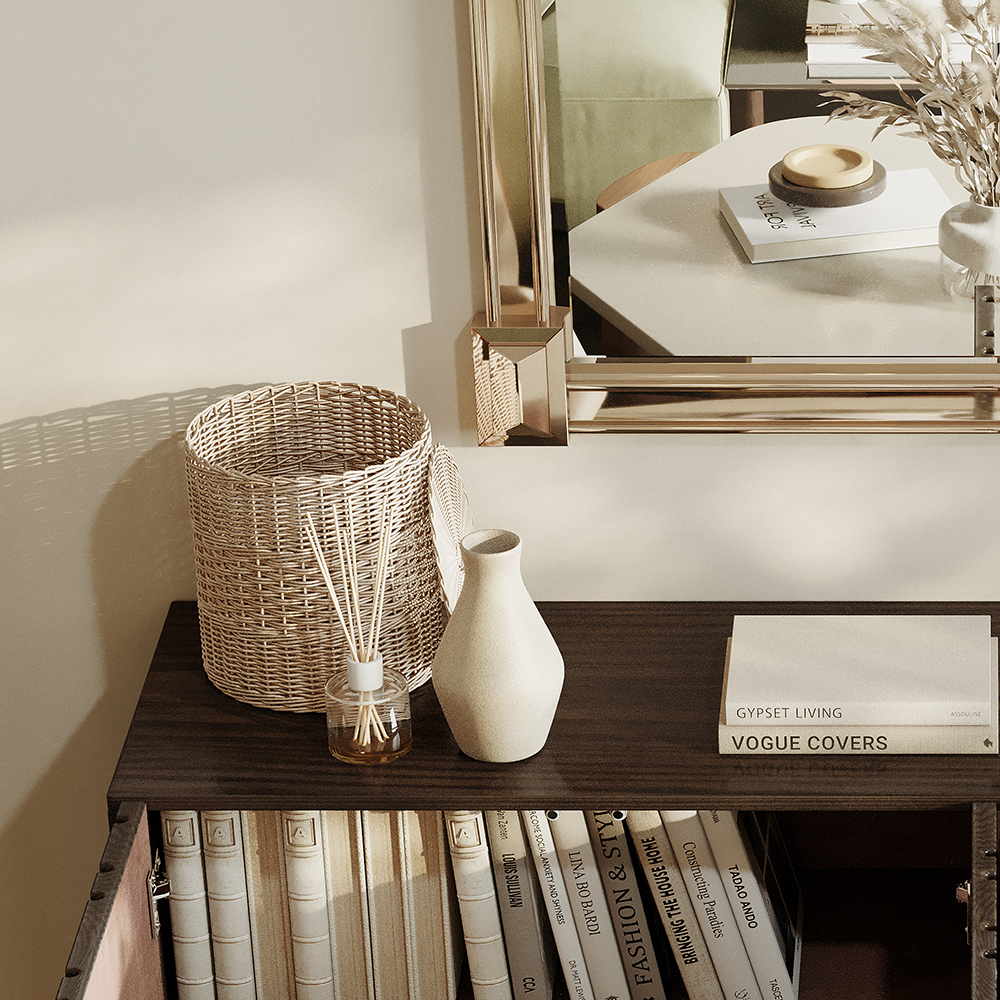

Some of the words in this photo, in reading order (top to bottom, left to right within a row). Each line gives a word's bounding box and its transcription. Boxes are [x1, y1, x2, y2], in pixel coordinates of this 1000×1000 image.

[736, 708, 790, 719] GYPSET
[795, 708, 842, 719] LIVING
[732, 736, 800, 750] VOGUE
[807, 736, 888, 750] COVERS
[535, 834, 548, 856] SOCIAL
[641, 837, 663, 865] HOME
[502, 853, 518, 874] LOUIS
[542, 857, 554, 882] ANXIETY
[568, 851, 586, 880] LINA
[608, 864, 627, 882] &
[506, 874, 524, 908] SULLIVAN
[548, 882, 558, 899] AND
[576, 882, 591, 898] BO
[652, 866, 674, 898] HOUSE
[682, 842, 710, 900] Constructing
[704, 900, 724, 938] Paradies
[663, 898, 681, 918] THE
[728, 864, 748, 899] TADAO
[740, 902, 758, 929] ANDO
[552, 899, 566, 926] SHYNESS
[581, 900, 601, 936] BARDI
[613, 888, 653, 986] FASHION
[670, 919, 698, 965] BRINGING
